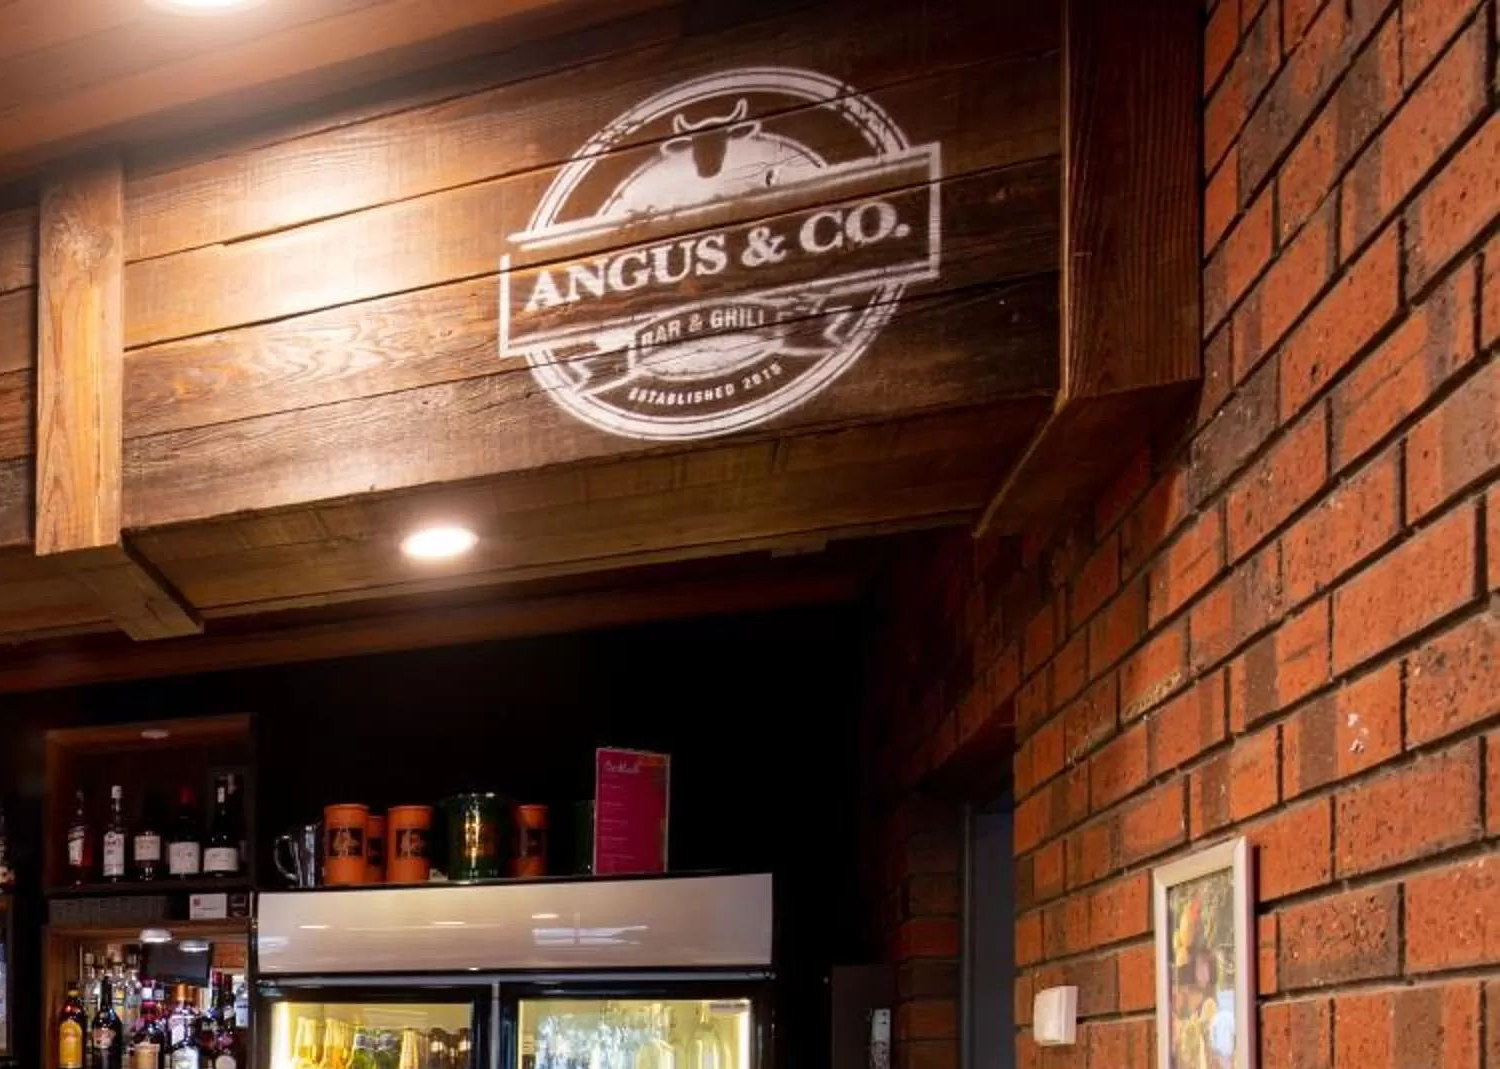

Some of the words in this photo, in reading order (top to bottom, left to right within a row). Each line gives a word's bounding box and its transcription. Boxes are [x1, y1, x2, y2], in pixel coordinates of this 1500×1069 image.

[524, 235, 728, 312] ANGUS
[741, 226, 787, 267] &
[800, 202, 911, 253] CO.
[641, 319, 681, 355] BAR
[688, 313, 703, 333] &
[628, 383, 736, 405] ESTABLISHED
